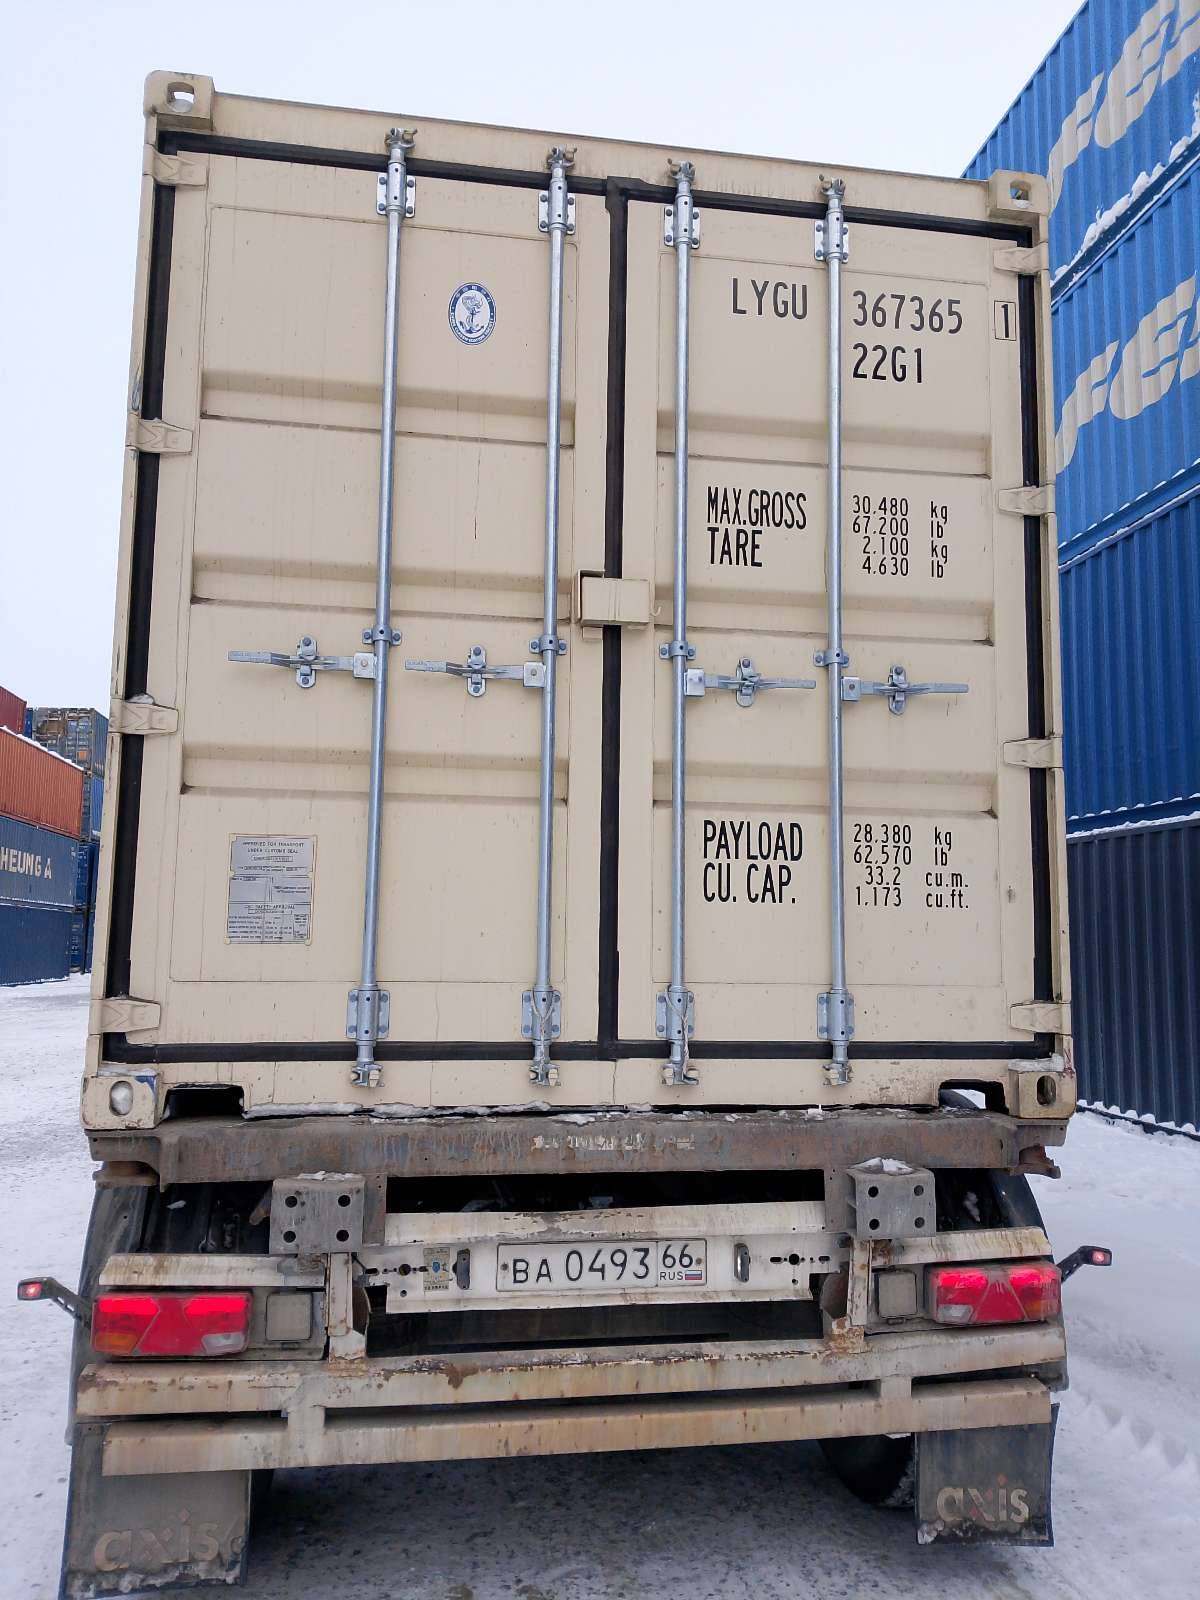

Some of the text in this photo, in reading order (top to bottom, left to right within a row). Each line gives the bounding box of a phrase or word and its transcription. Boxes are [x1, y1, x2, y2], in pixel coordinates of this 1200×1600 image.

[732, 277, 808, 320] LYGU
[852, 290, 963, 335] 367365
[852, 342, 923, 384] 22G1
[706, 485, 948, 530] MAX.GROSS 30.480 kg
[852, 516, 944, 539] 67.200 lb
[706, 527, 948, 568] TARE 2.100 kg
[861, 556, 944, 579] 4.630 lb
[703, 819, 952, 862] PAYLOAD 28.380 kg
[853, 845, 948, 867] 62.570 lb
[0, 846, 52, 879] HEUNG A
[702, 862, 969, 905] CU. CAP. 33.2 cu.m.
[855, 886, 969, 909] 1.173 cu.ft.
[565, 1247, 650, 1282] 0493
[662, 1243, 694, 1269] 66
[659, 1271, 684, 1281] RUS
